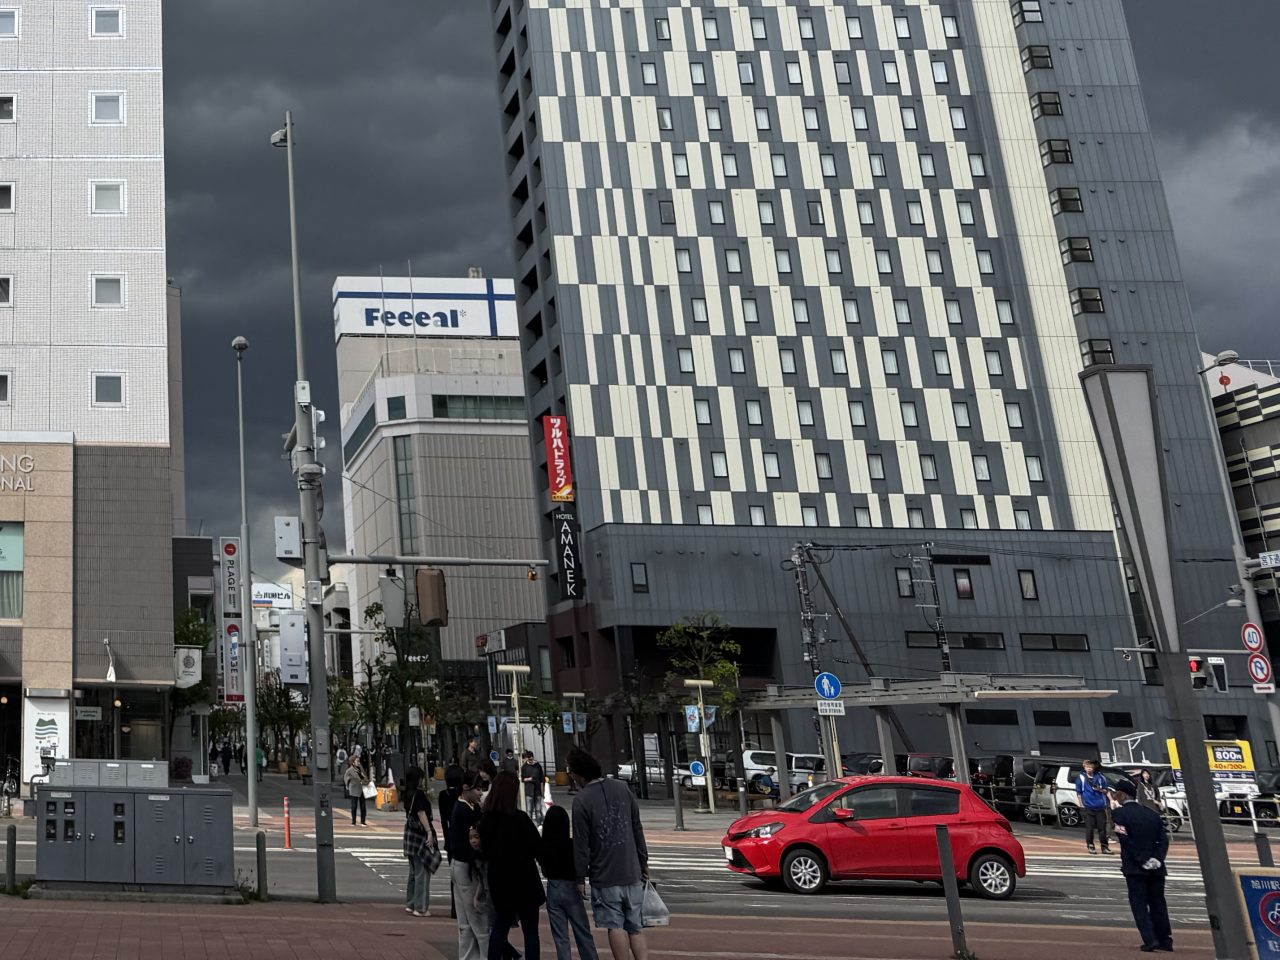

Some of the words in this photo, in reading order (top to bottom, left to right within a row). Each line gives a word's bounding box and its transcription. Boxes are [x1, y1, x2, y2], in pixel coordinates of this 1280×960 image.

[550, 417, 568, 488] ツルハドラッグ
[226, 559, 236, 592] PLAGE
[561, 521, 577, 597] AMANEK
[1247, 631, 1258, 644] 40
